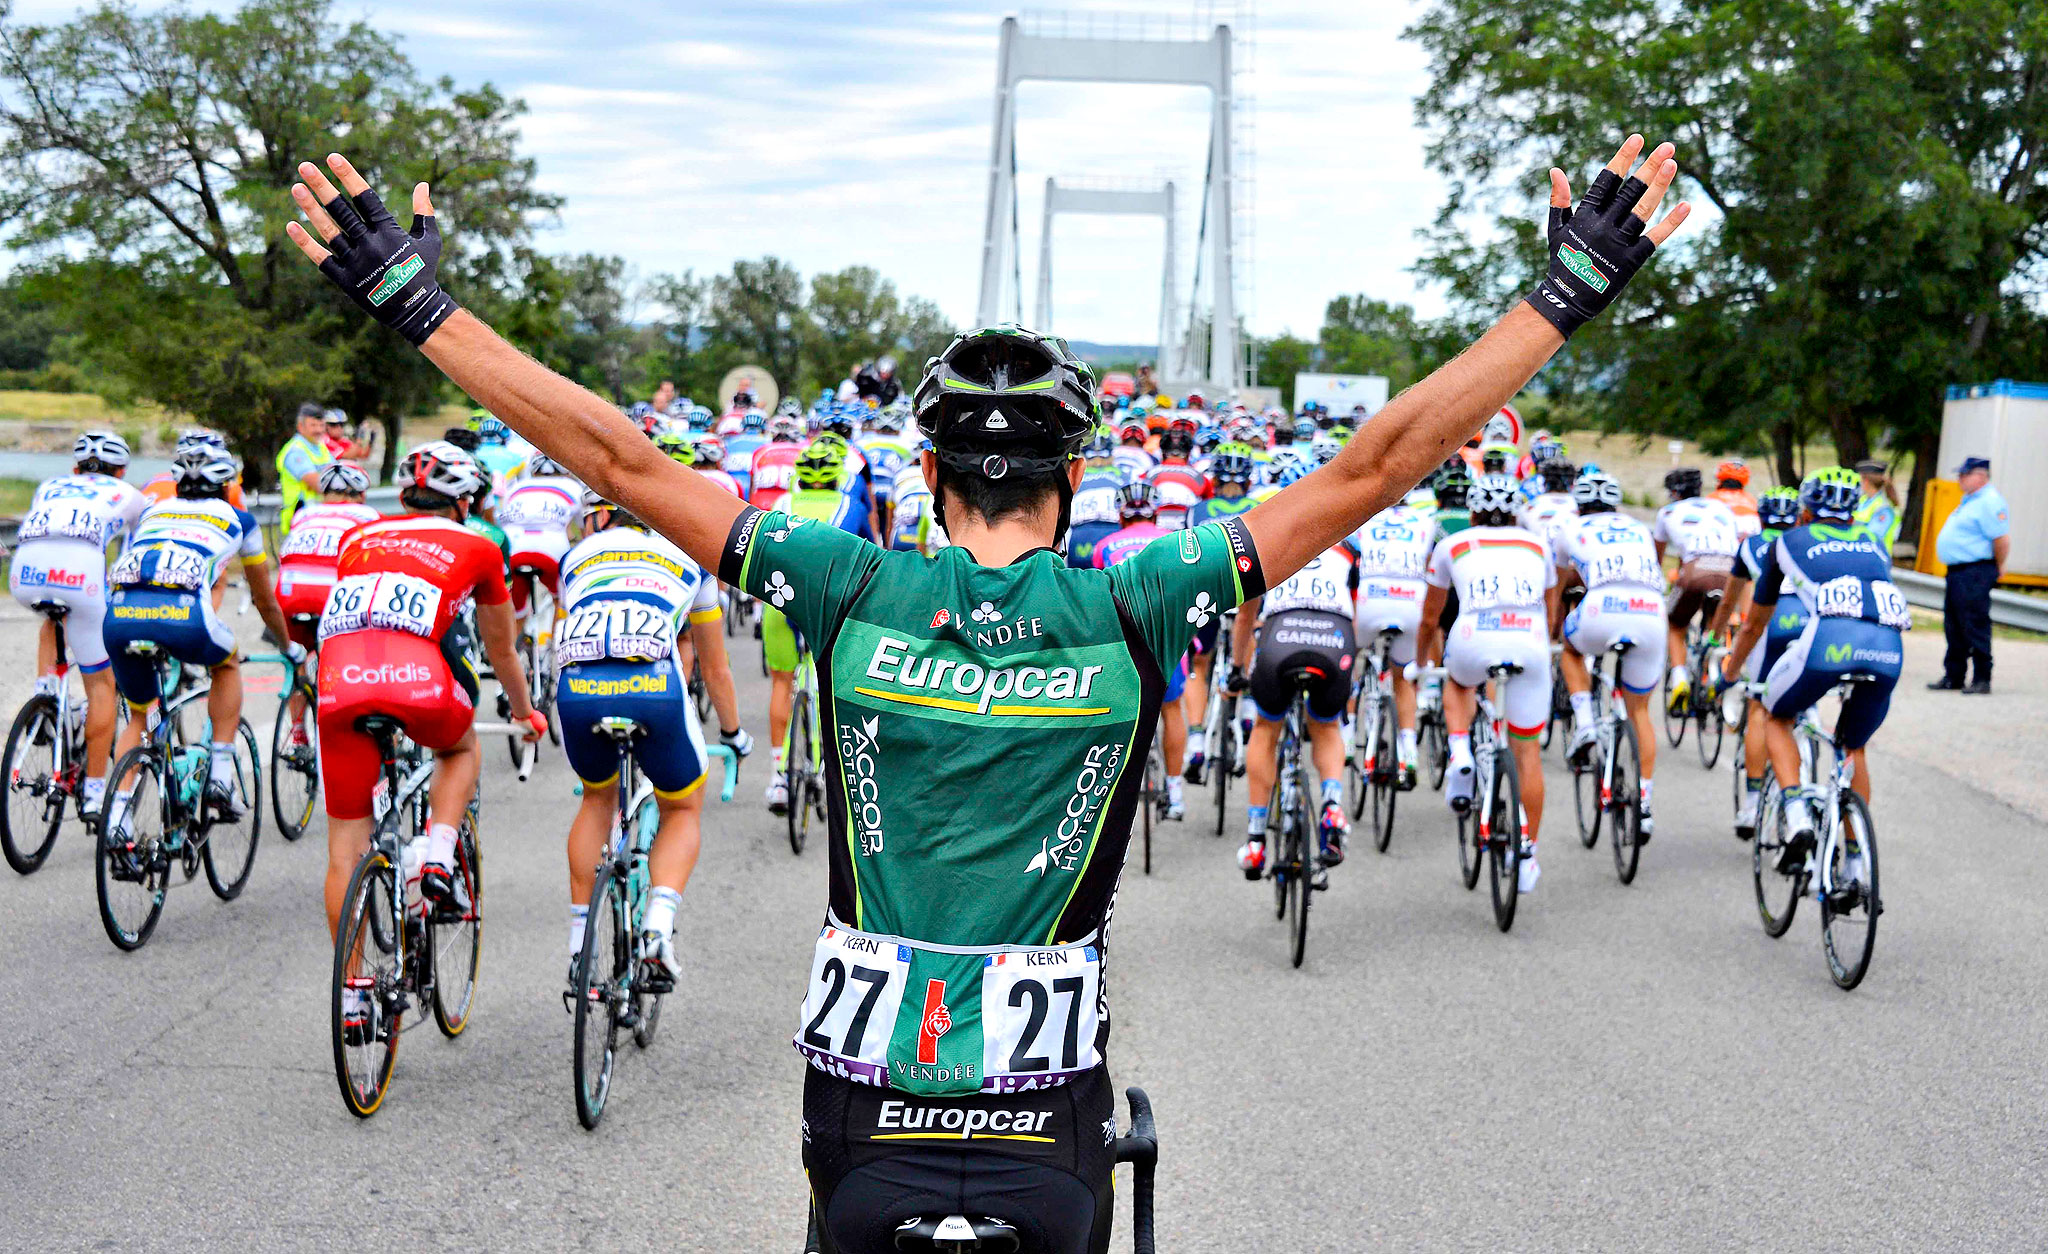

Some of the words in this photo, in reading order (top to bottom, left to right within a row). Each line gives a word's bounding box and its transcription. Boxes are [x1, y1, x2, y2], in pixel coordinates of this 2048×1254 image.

[384, 240, 411, 266] Partenaire
[1588, 247, 1619, 273] Partenaire
[356, 265, 385, 288] Nutrition
[20, 565, 87, 587] BigMat
[625, 576, 669, 594] DCM
[1311, 577, 1337, 600] 69
[328, 586, 365, 615] 86
[388, 583, 427, 618] 86
[1823, 584, 1861, 606] 168
[620, 608, 667, 643] 122
[1275, 630, 1345, 650] GARMIN
[341, 662, 432, 684] Cofidis
[568, 674, 668, 696] vacansOleil
[865, 635, 1104, 715] Europcar
[840, 724, 872, 857] HOTELS.COM
[852, 726, 885, 855] ACCOR
[1048, 743, 1110, 867] ACCOR
[1060, 743, 1124, 872] HOTELS.COM
[843, 935, 879, 956] KERN
[1026, 950, 1068, 967] KERN
[803, 957, 890, 1058] 27
[1007, 975, 1085, 1073] 27
[895, 1060, 975, 1082] VENDÉE
[877, 1100, 1053, 1140] Europcar
